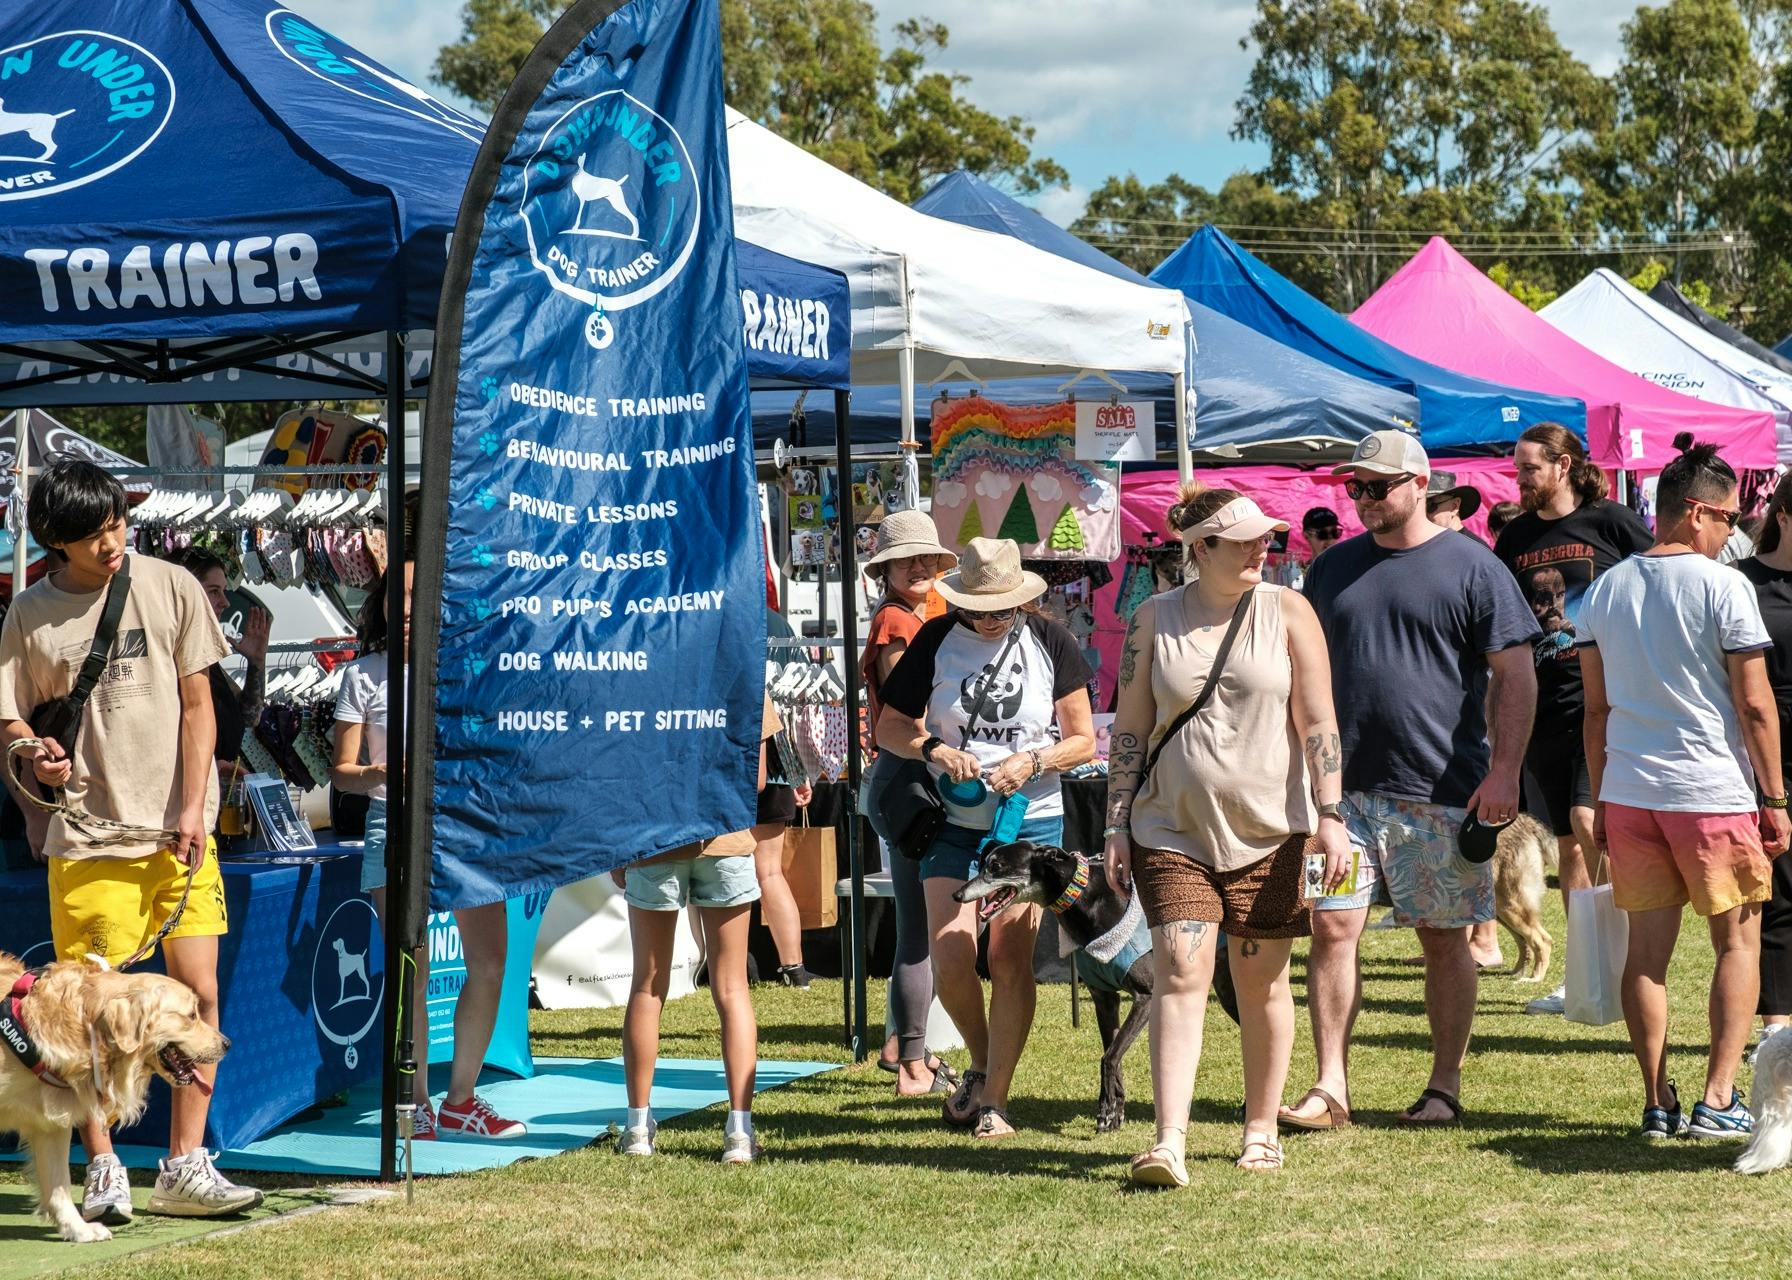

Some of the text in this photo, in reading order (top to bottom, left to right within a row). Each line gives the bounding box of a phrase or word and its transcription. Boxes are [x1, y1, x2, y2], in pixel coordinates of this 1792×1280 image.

[58, 40, 155, 122] UNDER
[24, 232, 322, 312] TRAINER
[547, 245, 660, 288] DOG TRAINER
[739, 288, 830, 360] RAINER
[510, 382, 706, 417] OBEDIENCE TRAINING
[1097, 410, 1135, 427] SALE
[506, 437, 736, 472] BEHAVIOURAL TRAINING
[509, 492, 678, 524] PRIVATE LESSONS
[507, 549, 668, 572] GROUP CLASSES
[1542, 543, 1595, 561] SEGURA
[502, 590, 725, 618] PRO PUP'S ACADEMY
[498, 651, 648, 671] DOG WALKING
[498, 708, 727, 731] HOUSE + PET SITTING
[957, 726, 1022, 742] WWF
[0, 1018, 28, 1053] SUMO
